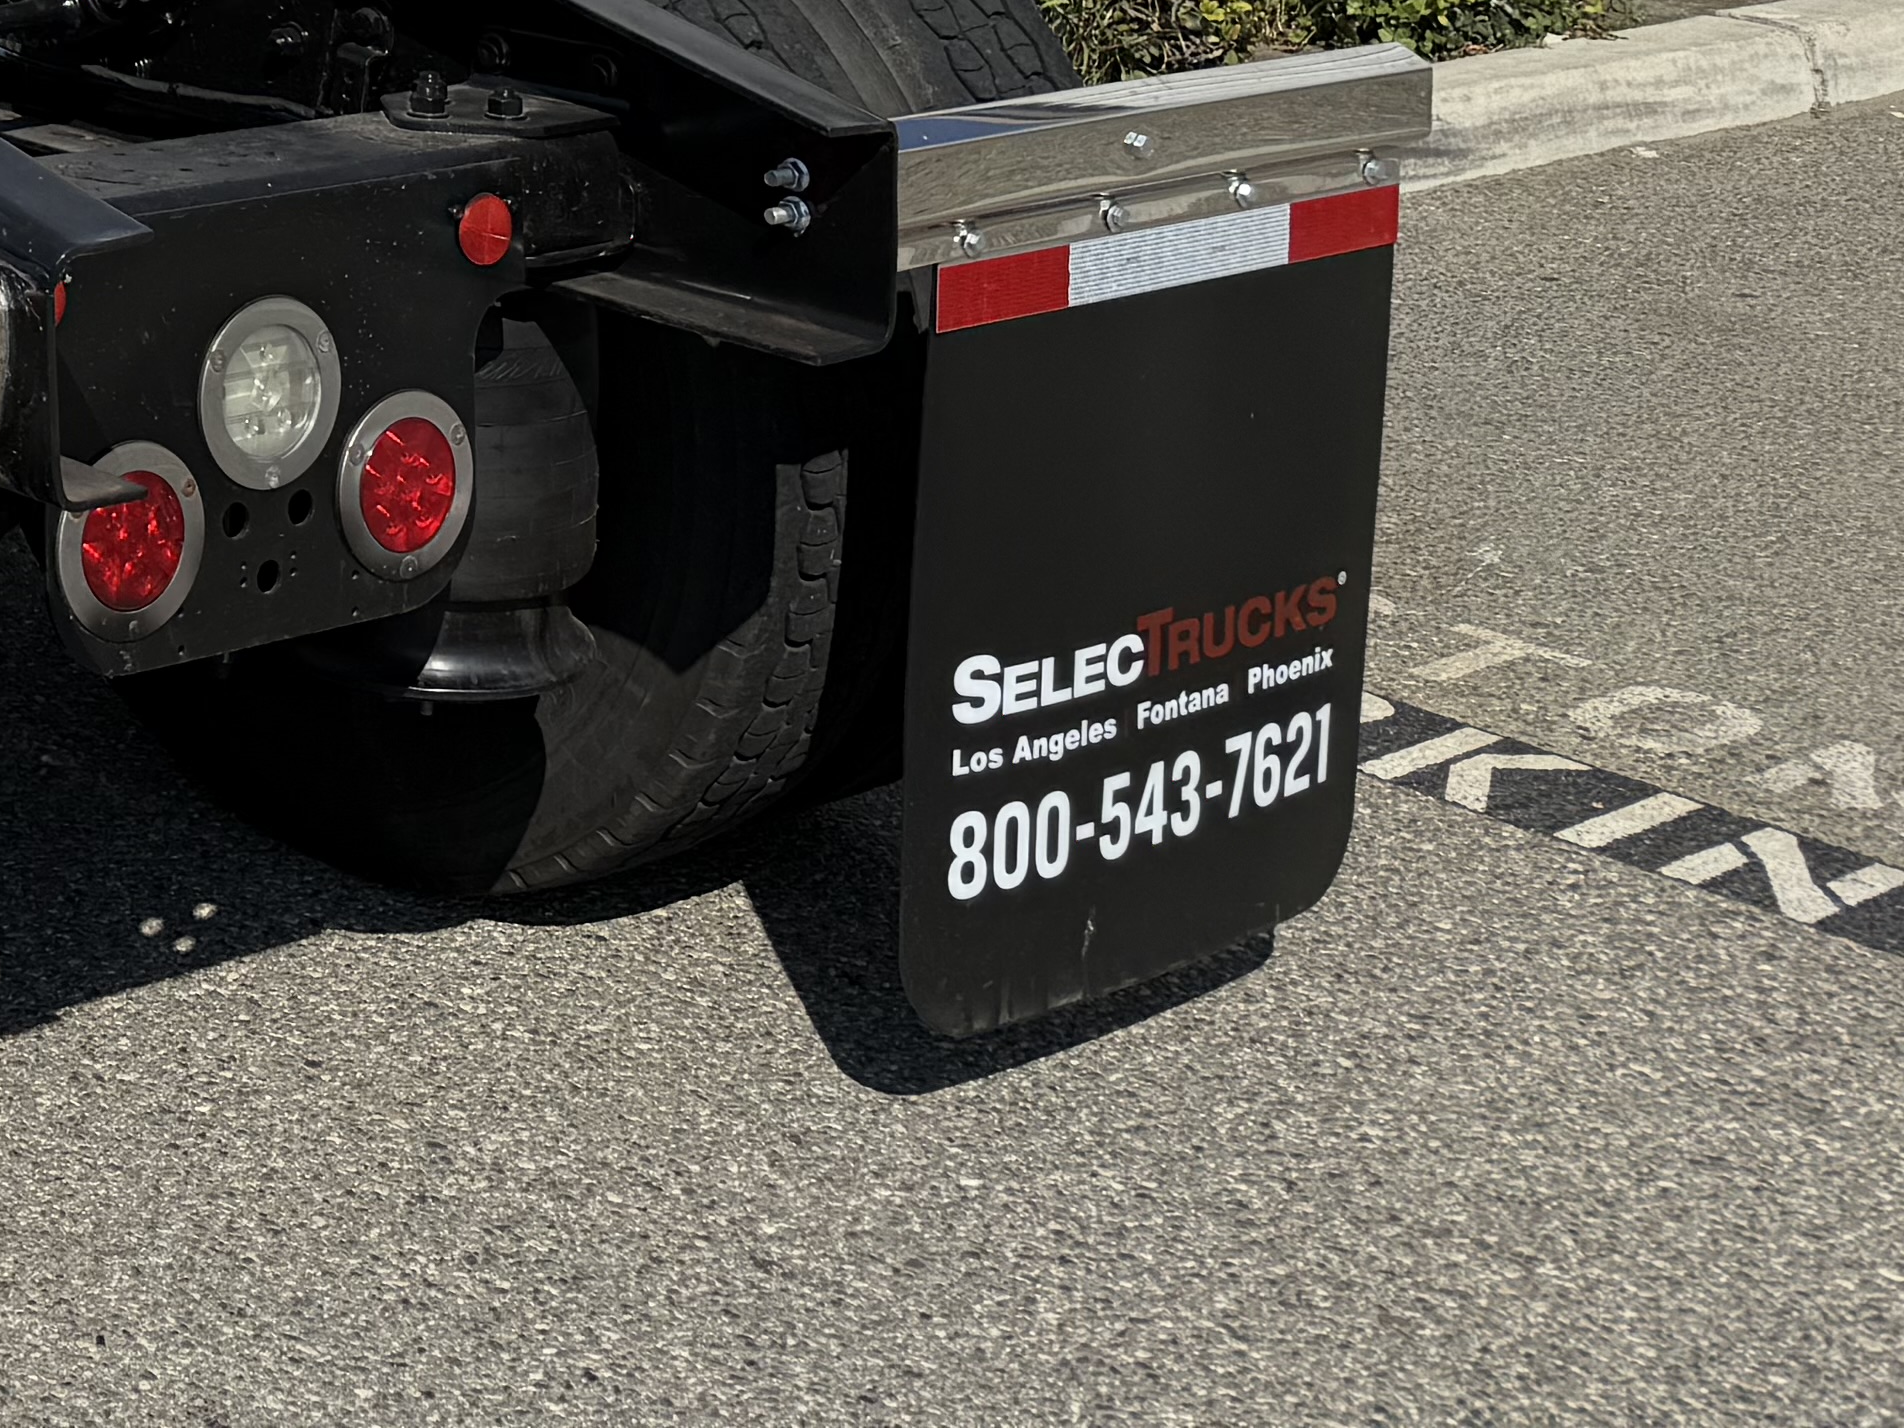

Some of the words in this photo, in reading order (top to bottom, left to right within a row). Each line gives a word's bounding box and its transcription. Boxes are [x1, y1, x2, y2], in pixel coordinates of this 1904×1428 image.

[952, 747, 1004, 777] Los
[1012, 718, 1118, 764] Angeles
[1137, 683, 1230, 730] Fontana
[1247, 647, 1334, 695] Phoenix
[947, 702, 1332, 900] 800-543-7621
